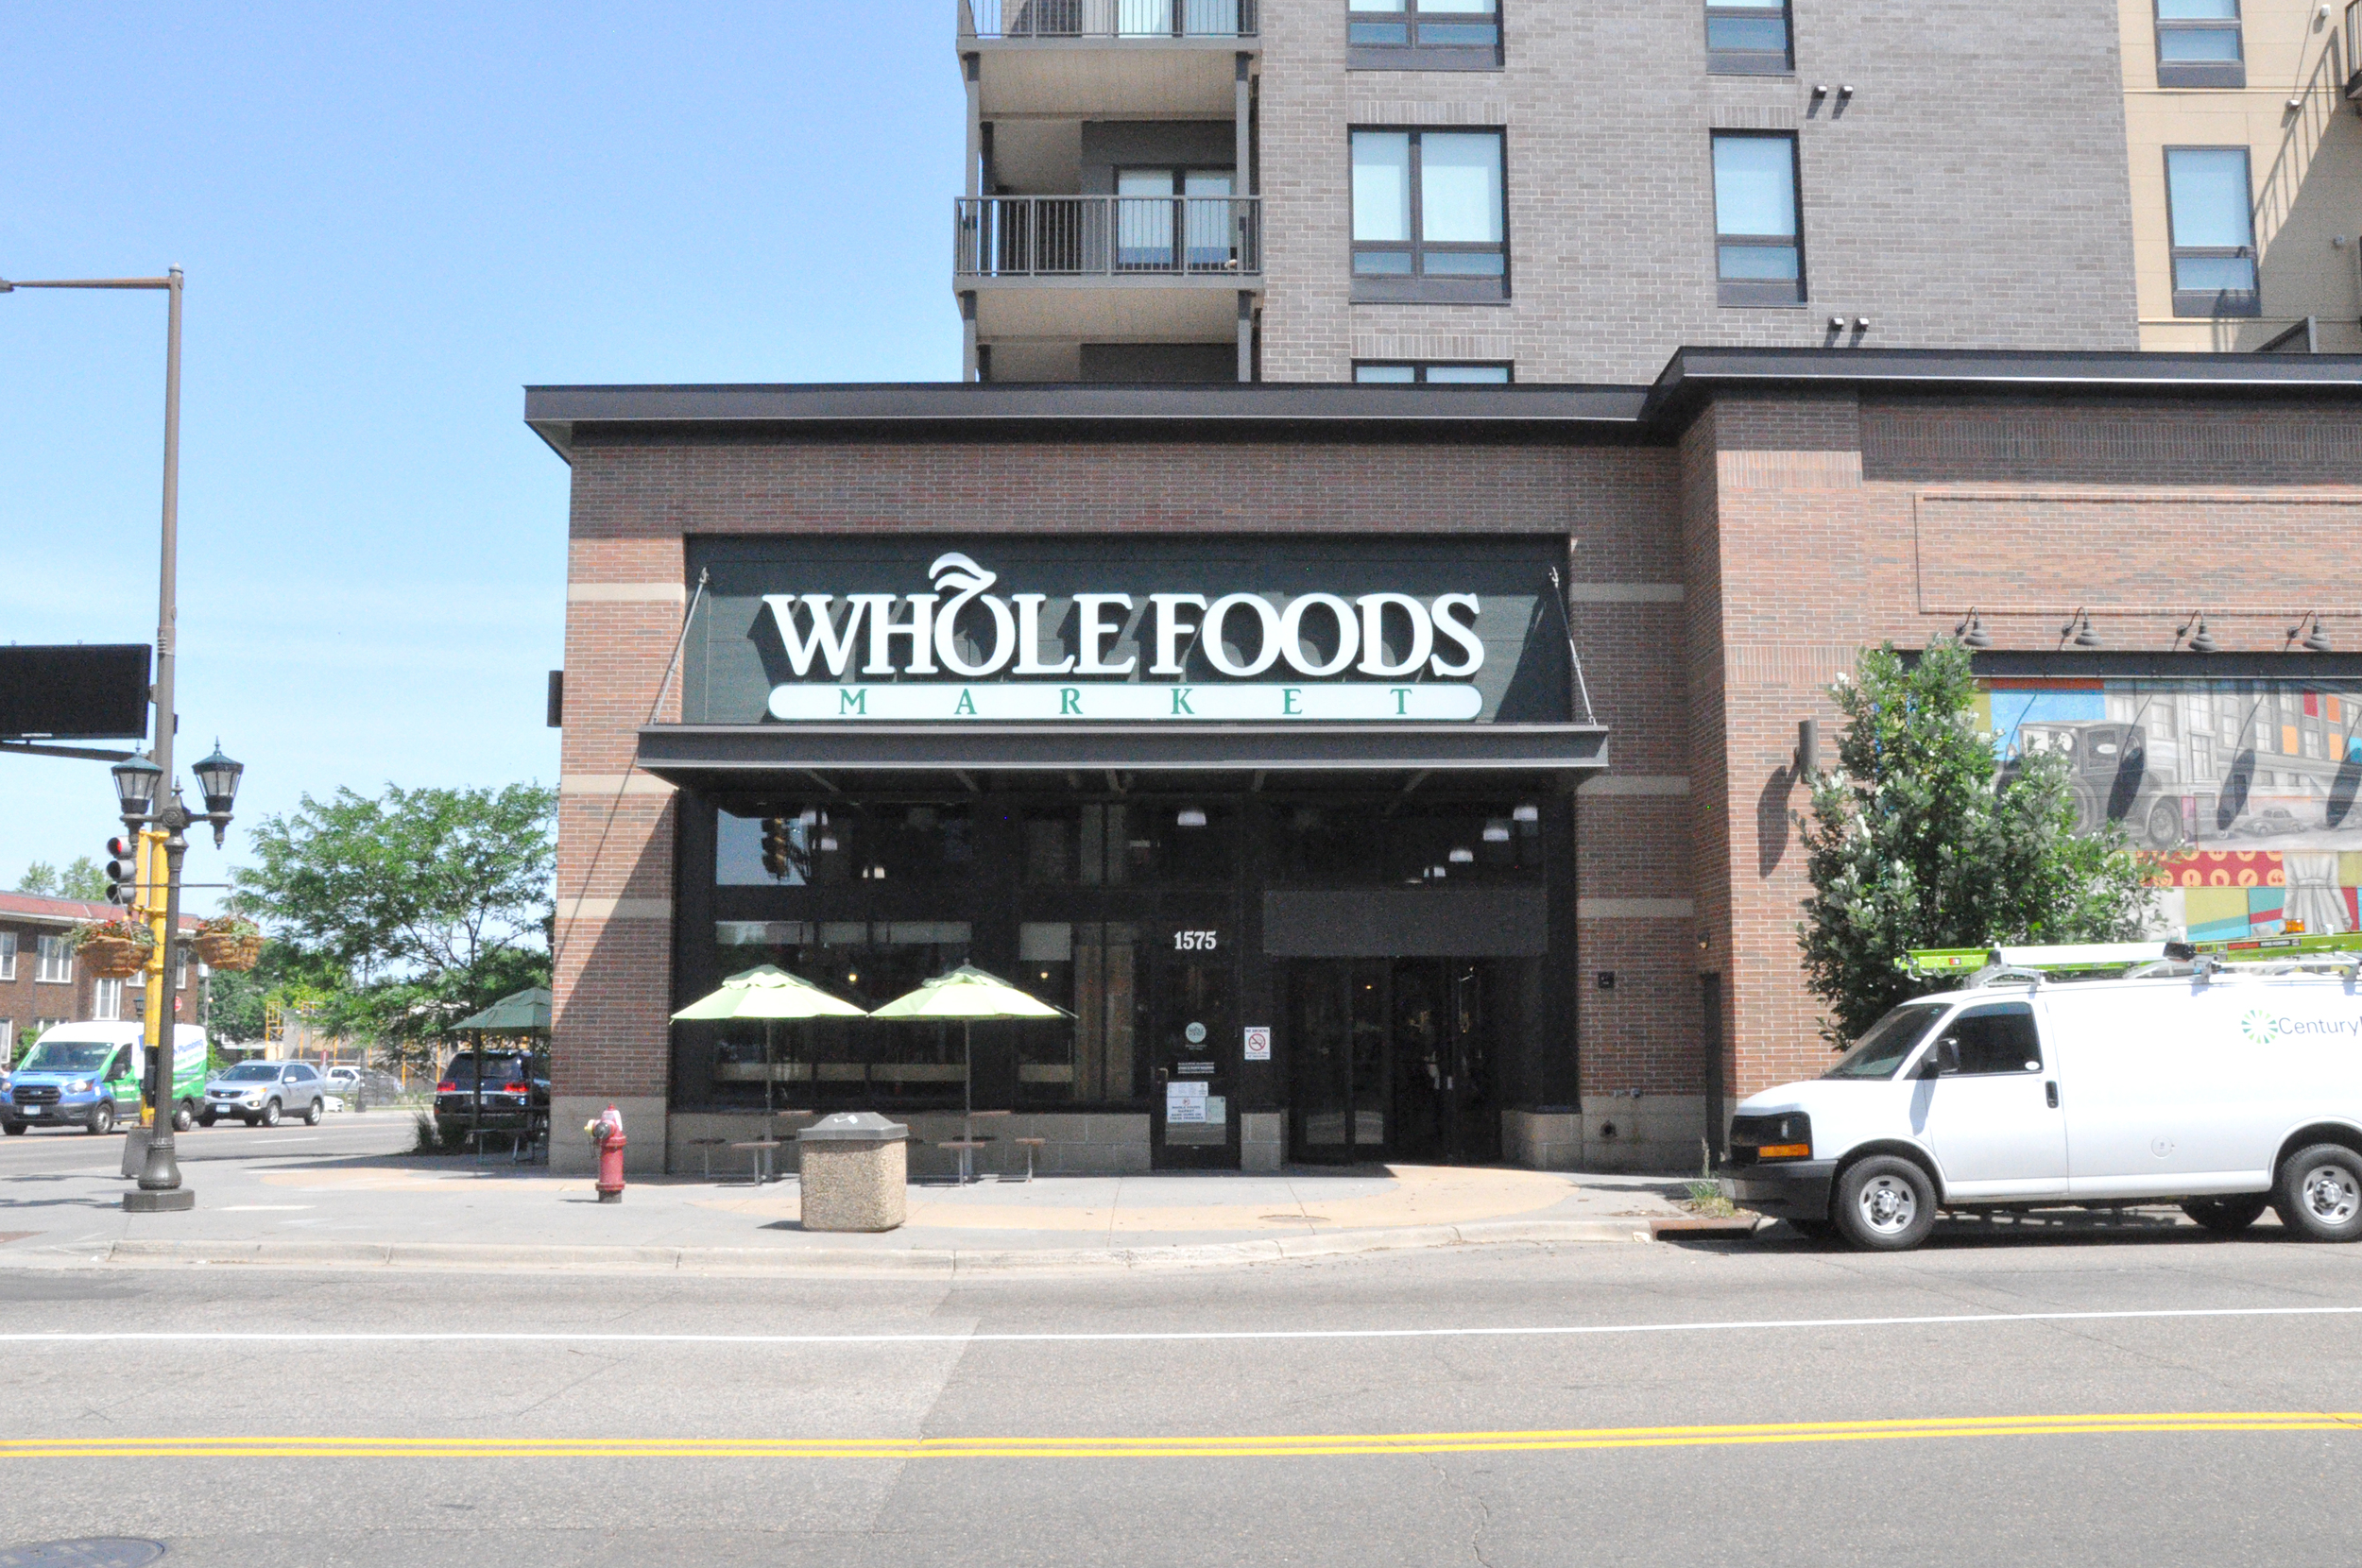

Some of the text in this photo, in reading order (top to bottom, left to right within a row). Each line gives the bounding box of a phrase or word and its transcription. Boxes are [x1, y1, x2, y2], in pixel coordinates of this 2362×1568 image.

[762, 553, 1485, 676] WHOLE FOODS
[838, 688, 1412, 715] MARKET
[1174, 930, 1217, 950] 1575
[2278, 1015, 2362, 1037] Century
